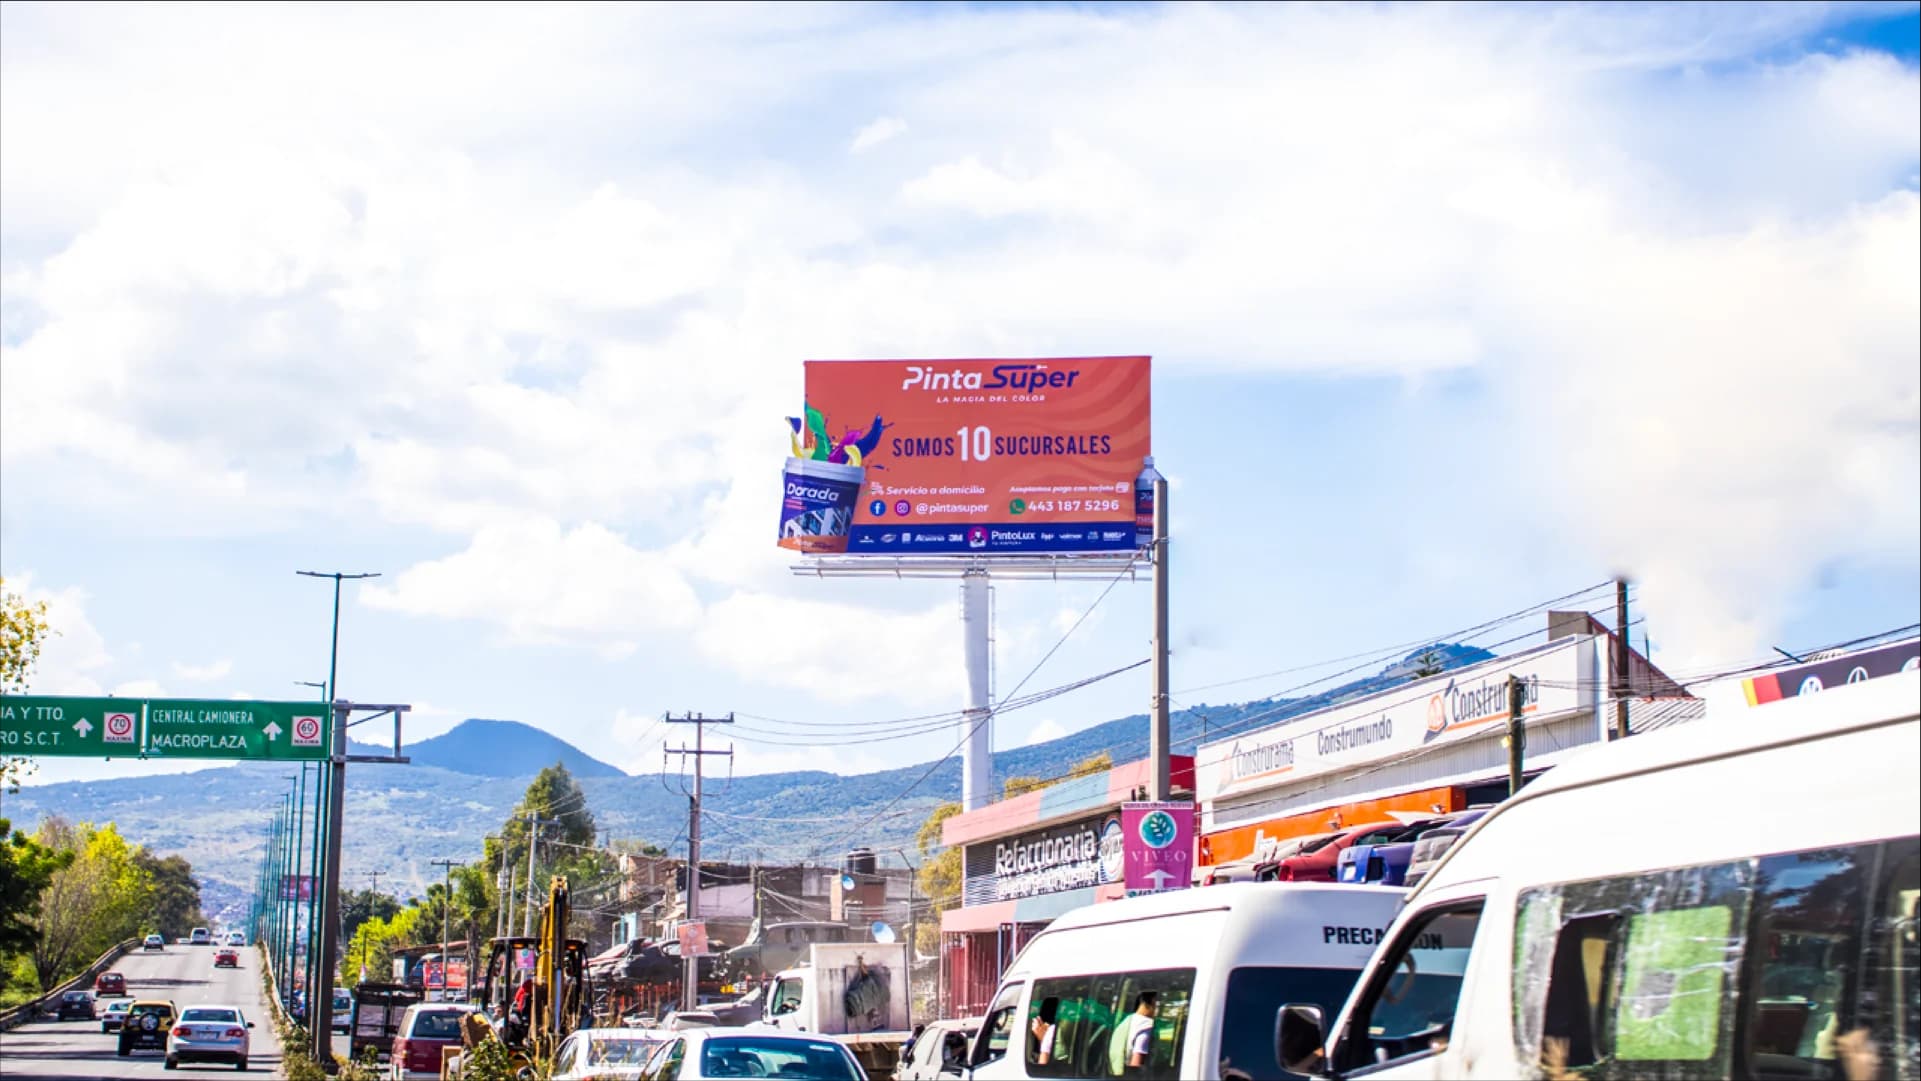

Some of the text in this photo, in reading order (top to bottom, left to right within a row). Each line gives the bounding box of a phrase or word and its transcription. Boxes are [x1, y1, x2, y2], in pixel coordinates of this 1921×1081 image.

[902, 366, 982, 390] Pinta
[1012, 394, 1045, 402] COLOR
[892, 425, 1111, 462] SOMOS 10 SUCURSALES
[787, 482, 839, 501] Dorada
[886, 485, 928, 496] Servicio
[916, 502, 989, 515] @pintasuper
[1028, 500, 1119, 512] 443 187 5296
[992, 530, 1036, 540] PintoLux
[21, 706, 31, 719] Y
[153, 709, 253, 724] CENTRAL CAMIONERA
[114, 718, 126, 728] 70
[301, 722, 314, 732] 60
[152, 734, 247, 748] MACROPLAZA
[1317, 713, 1392, 756] Construmundo
[1236, 740, 1294, 777] Construrama
[995, 824, 1098, 876] Refaccionaria
[1131, 850, 1186, 862] VIVEO
